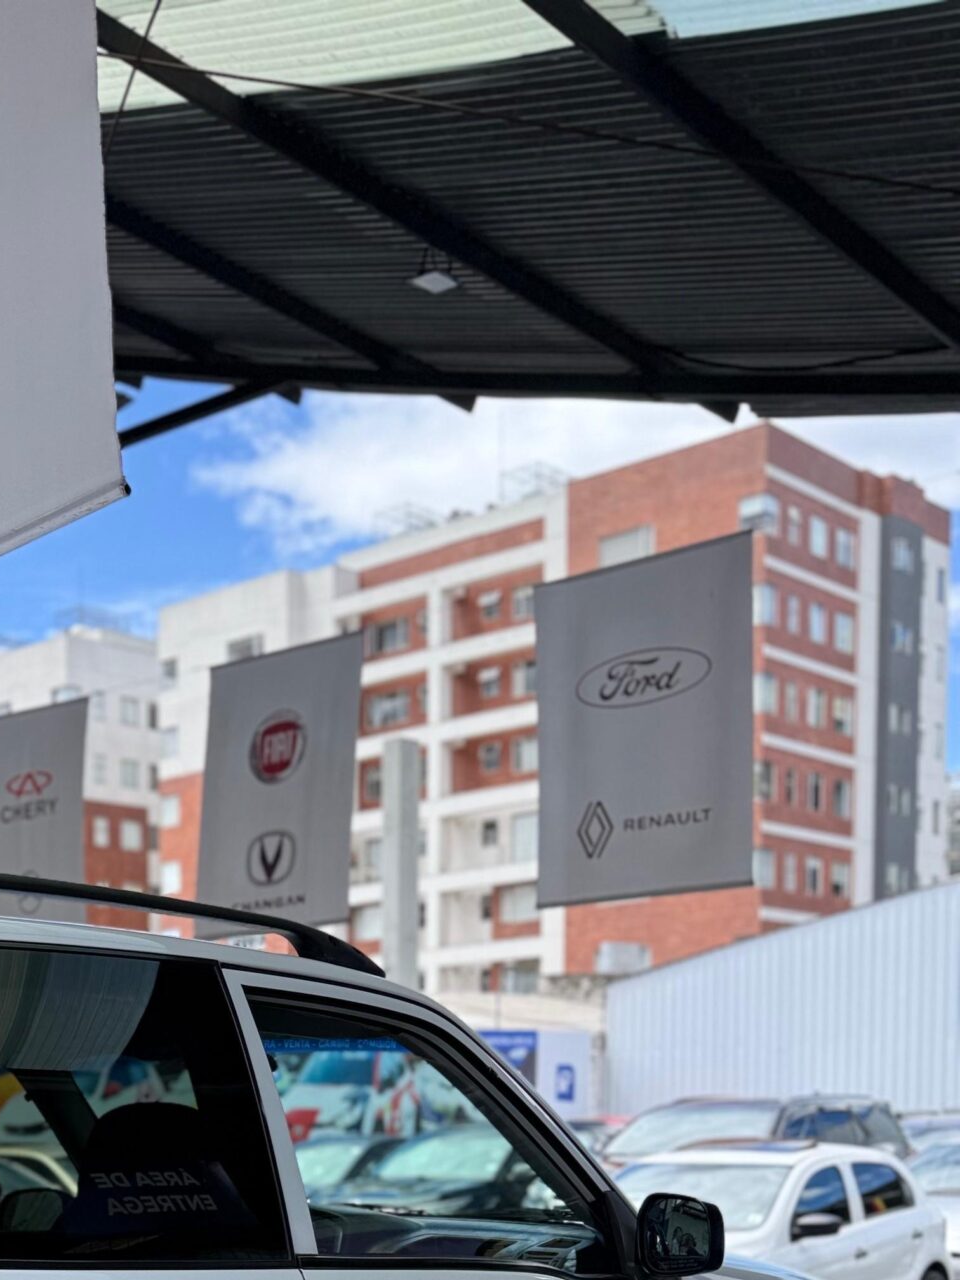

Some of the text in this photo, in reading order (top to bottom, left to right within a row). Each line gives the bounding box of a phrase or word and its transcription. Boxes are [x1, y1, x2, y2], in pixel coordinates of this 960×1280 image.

[598, 656, 682, 701] Ford
[261, 730, 296, 767] FIAT
[0, 799, 60, 824] CHERY
[623, 807, 712, 832] RENAULT
